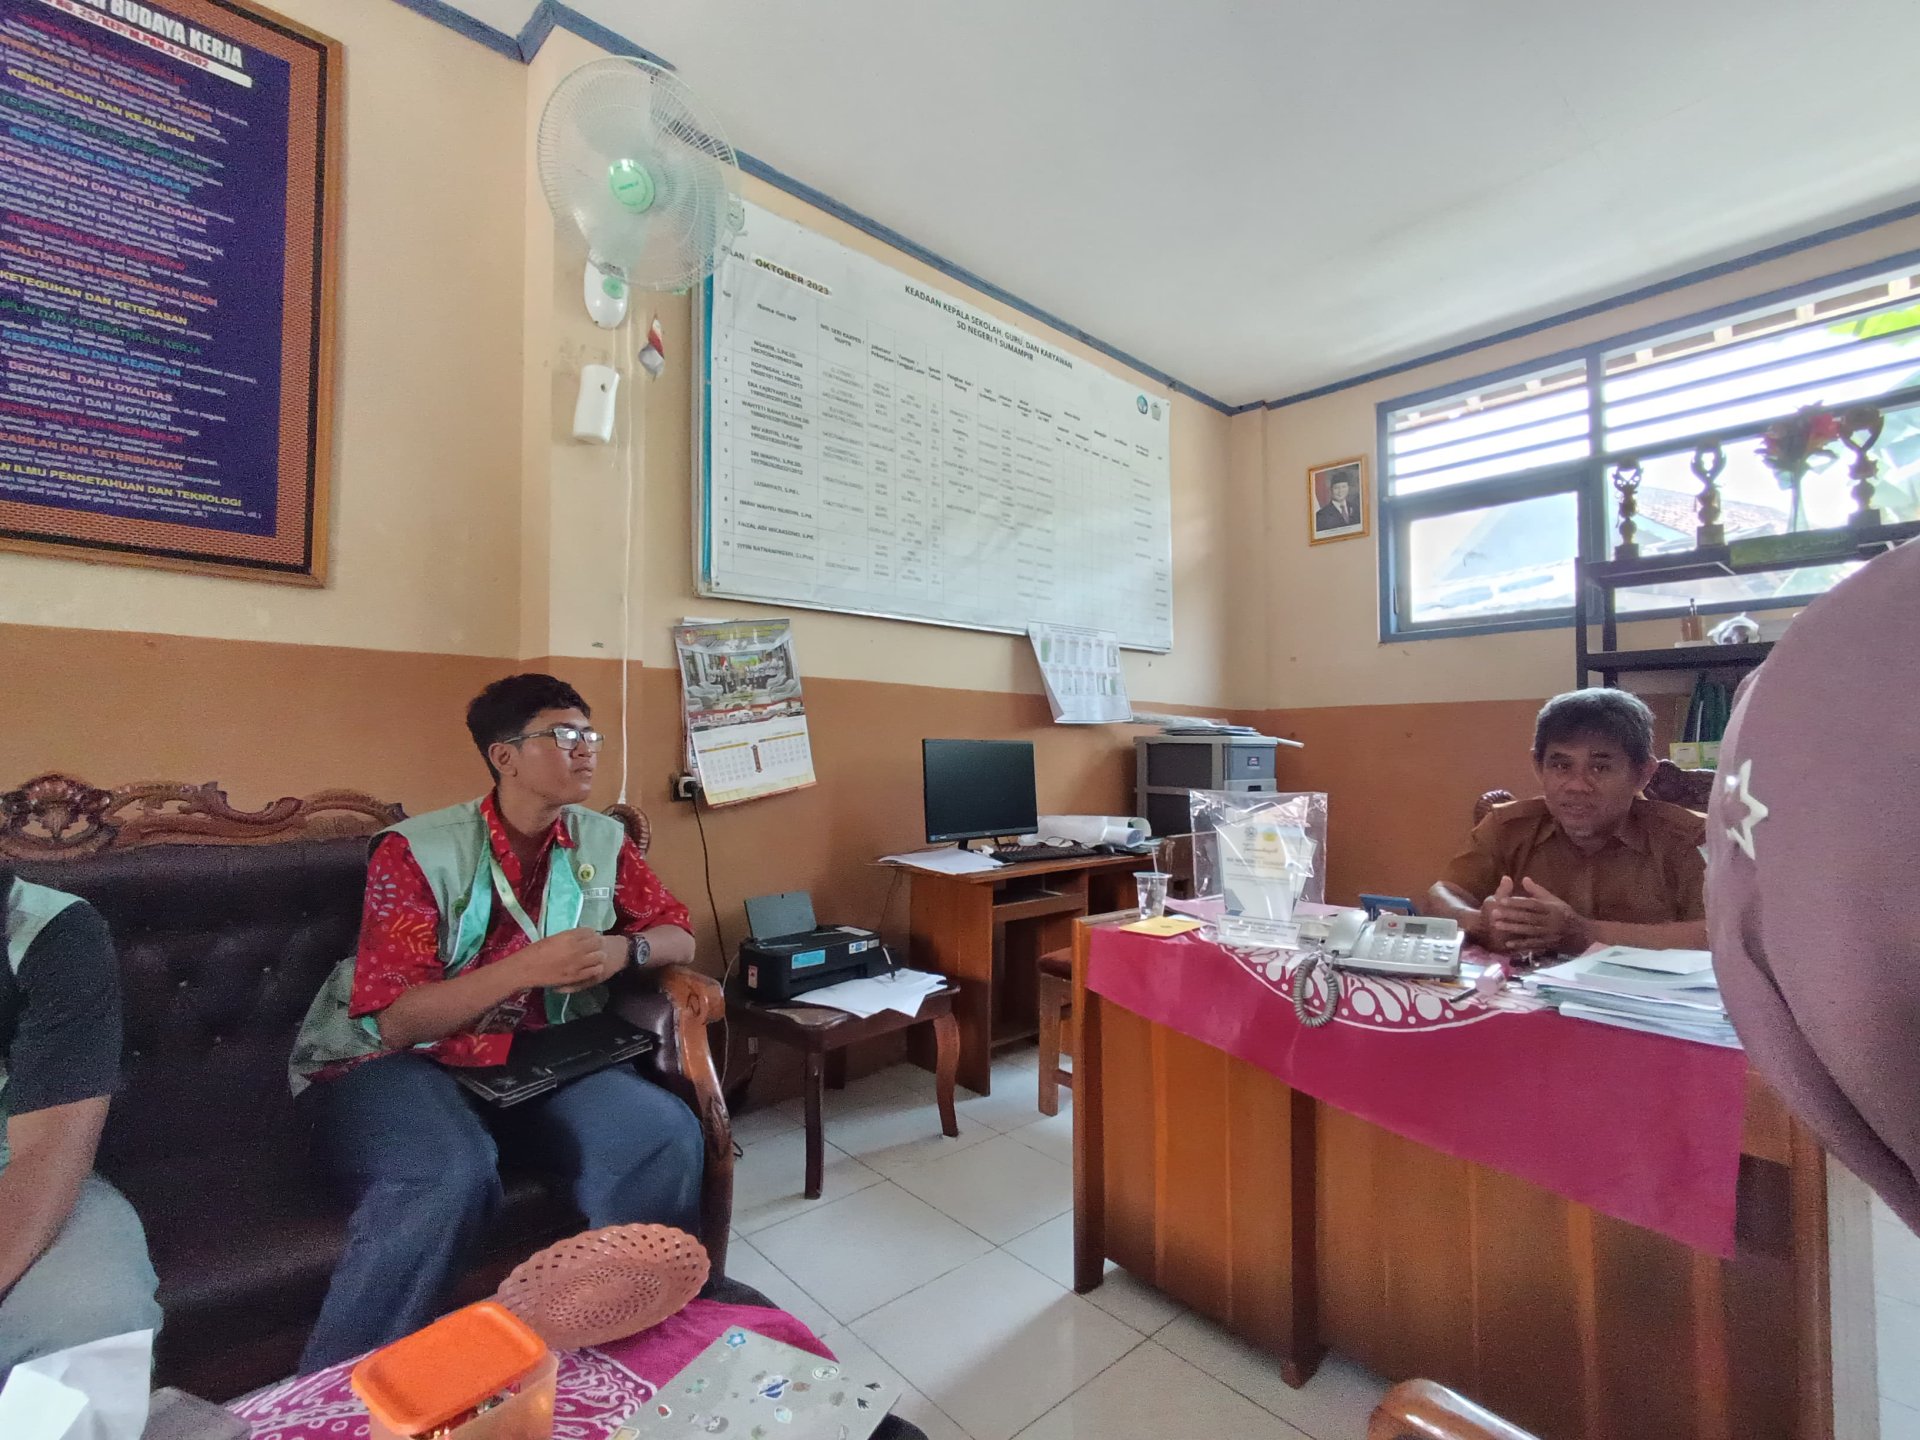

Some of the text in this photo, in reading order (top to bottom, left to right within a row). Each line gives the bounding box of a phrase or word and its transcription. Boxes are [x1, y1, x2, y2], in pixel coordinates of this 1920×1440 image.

[110, 0, 186, 45] BUDAYA
[189, 26, 242, 68] KERJA
[96, 99, 121, 116] DAN
[125, 109, 195, 143] KEJUJURAN
[91, 180, 117, 197] DAN
[120, 190, 206, 225] KETELADANAN
[68, 201, 95, 218] DAN
[99, 211, 157, 236] DINAMIKA
[160, 230, 223, 257] KELOMPOK
[96, 266, 178, 297] KECERDASAN
[721, 245, 829, 296] LAN OKTOBER 2023
[0, 270, 81, 299] KETEGUHAN
[84, 291, 111, 306] DAN
[114, 299, 187, 326] KETEGASAN
[905, 285, 941, 308] KEADAAN
[943, 303, 970, 322] KEPALA
[1025, 341, 1040, 354] DAN
[1040, 347, 1073, 369] KARYAWAN
[956, 320, 967, 331] SD
[968, 325, 993, 342] NEGERI
[999, 339, 1034, 361] SUMAMPIR
[91, 350, 117, 363] DAN
[8, 360, 71, 381] DEDIKASI
[77, 374, 104, 388] DAN
[108, 381, 172, 402] LOYALITAS
[8, 382, 171, 421] SEMANGAT DAN MOTIVASI
[0, 432, 58, 450] EADILAN
[61, 442, 88, 455] DAN
[92, 448, 183, 470] KETERBUKAAN
[50, 470, 144, 492] PENGETAHUAN
[148, 485, 172, 497] DAN
[176, 489, 241, 507] TEKNOLOGI
